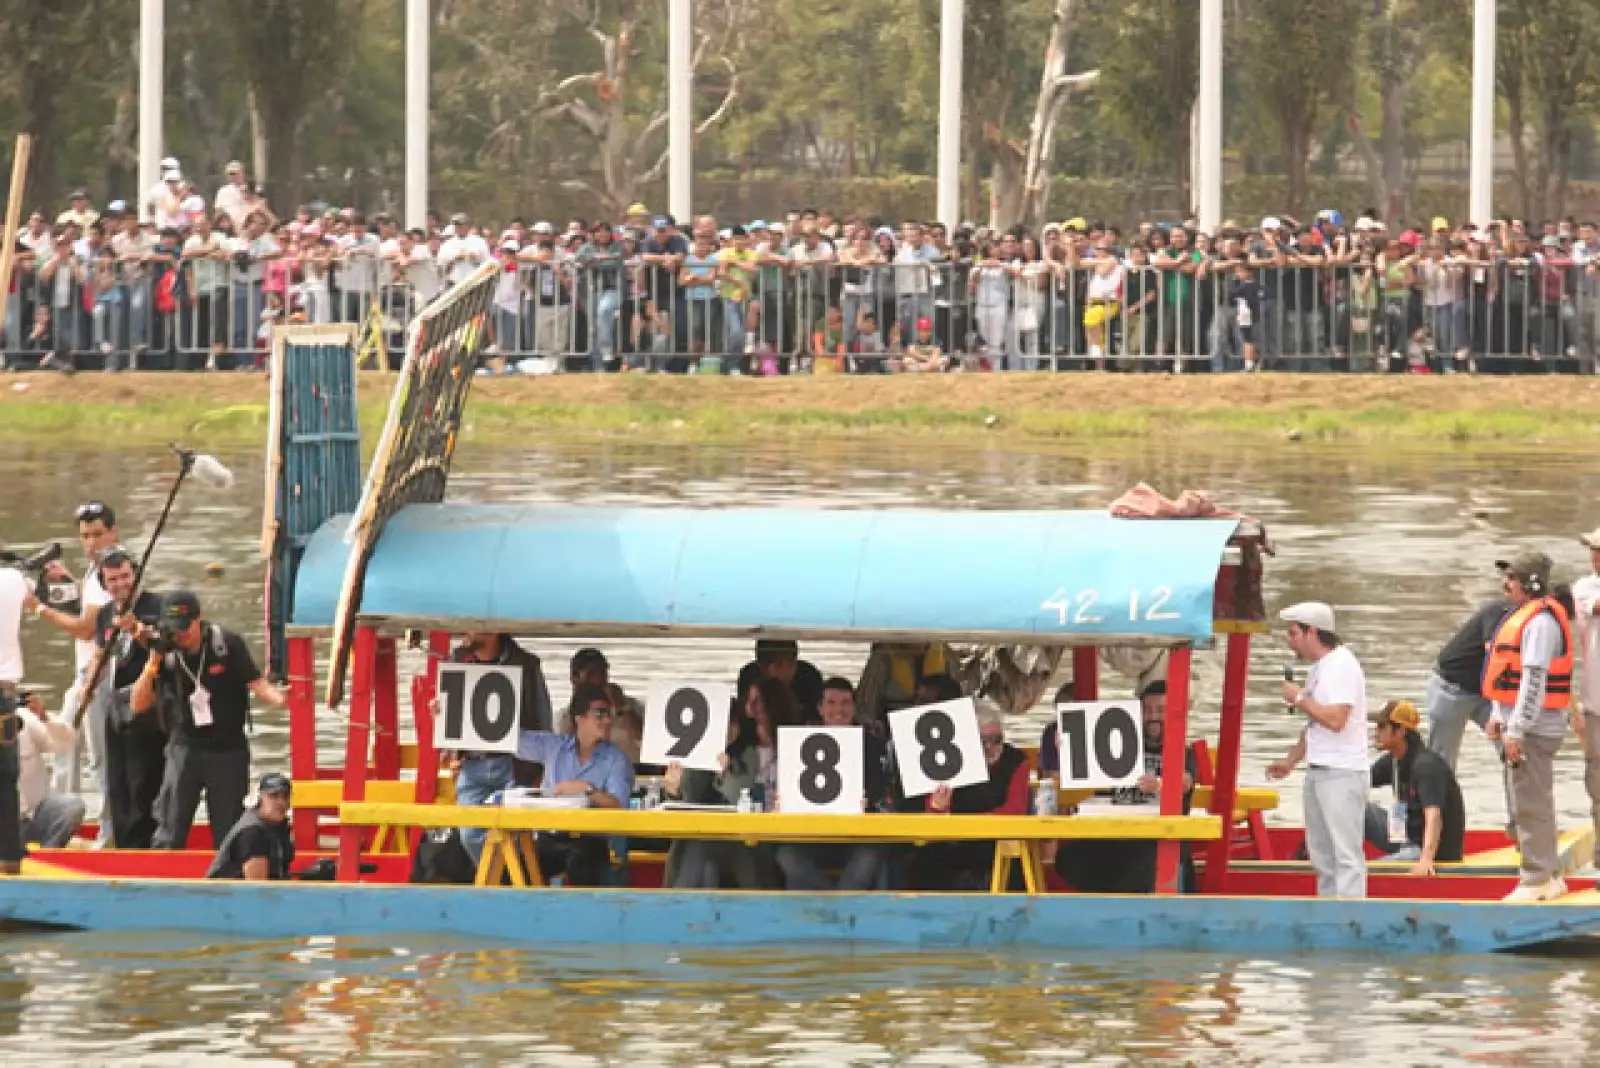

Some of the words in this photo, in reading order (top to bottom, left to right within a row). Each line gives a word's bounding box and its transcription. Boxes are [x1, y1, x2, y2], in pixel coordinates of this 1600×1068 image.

[1040, 586, 1101, 625] 42
[1129, 585, 1181, 621] 12
[439, 670, 516, 743] 10
[665, 687, 710, 758] 9
[799, 733, 843, 805] 8
[915, 710, 963, 781] 8
[1061, 707, 1138, 781] 10
